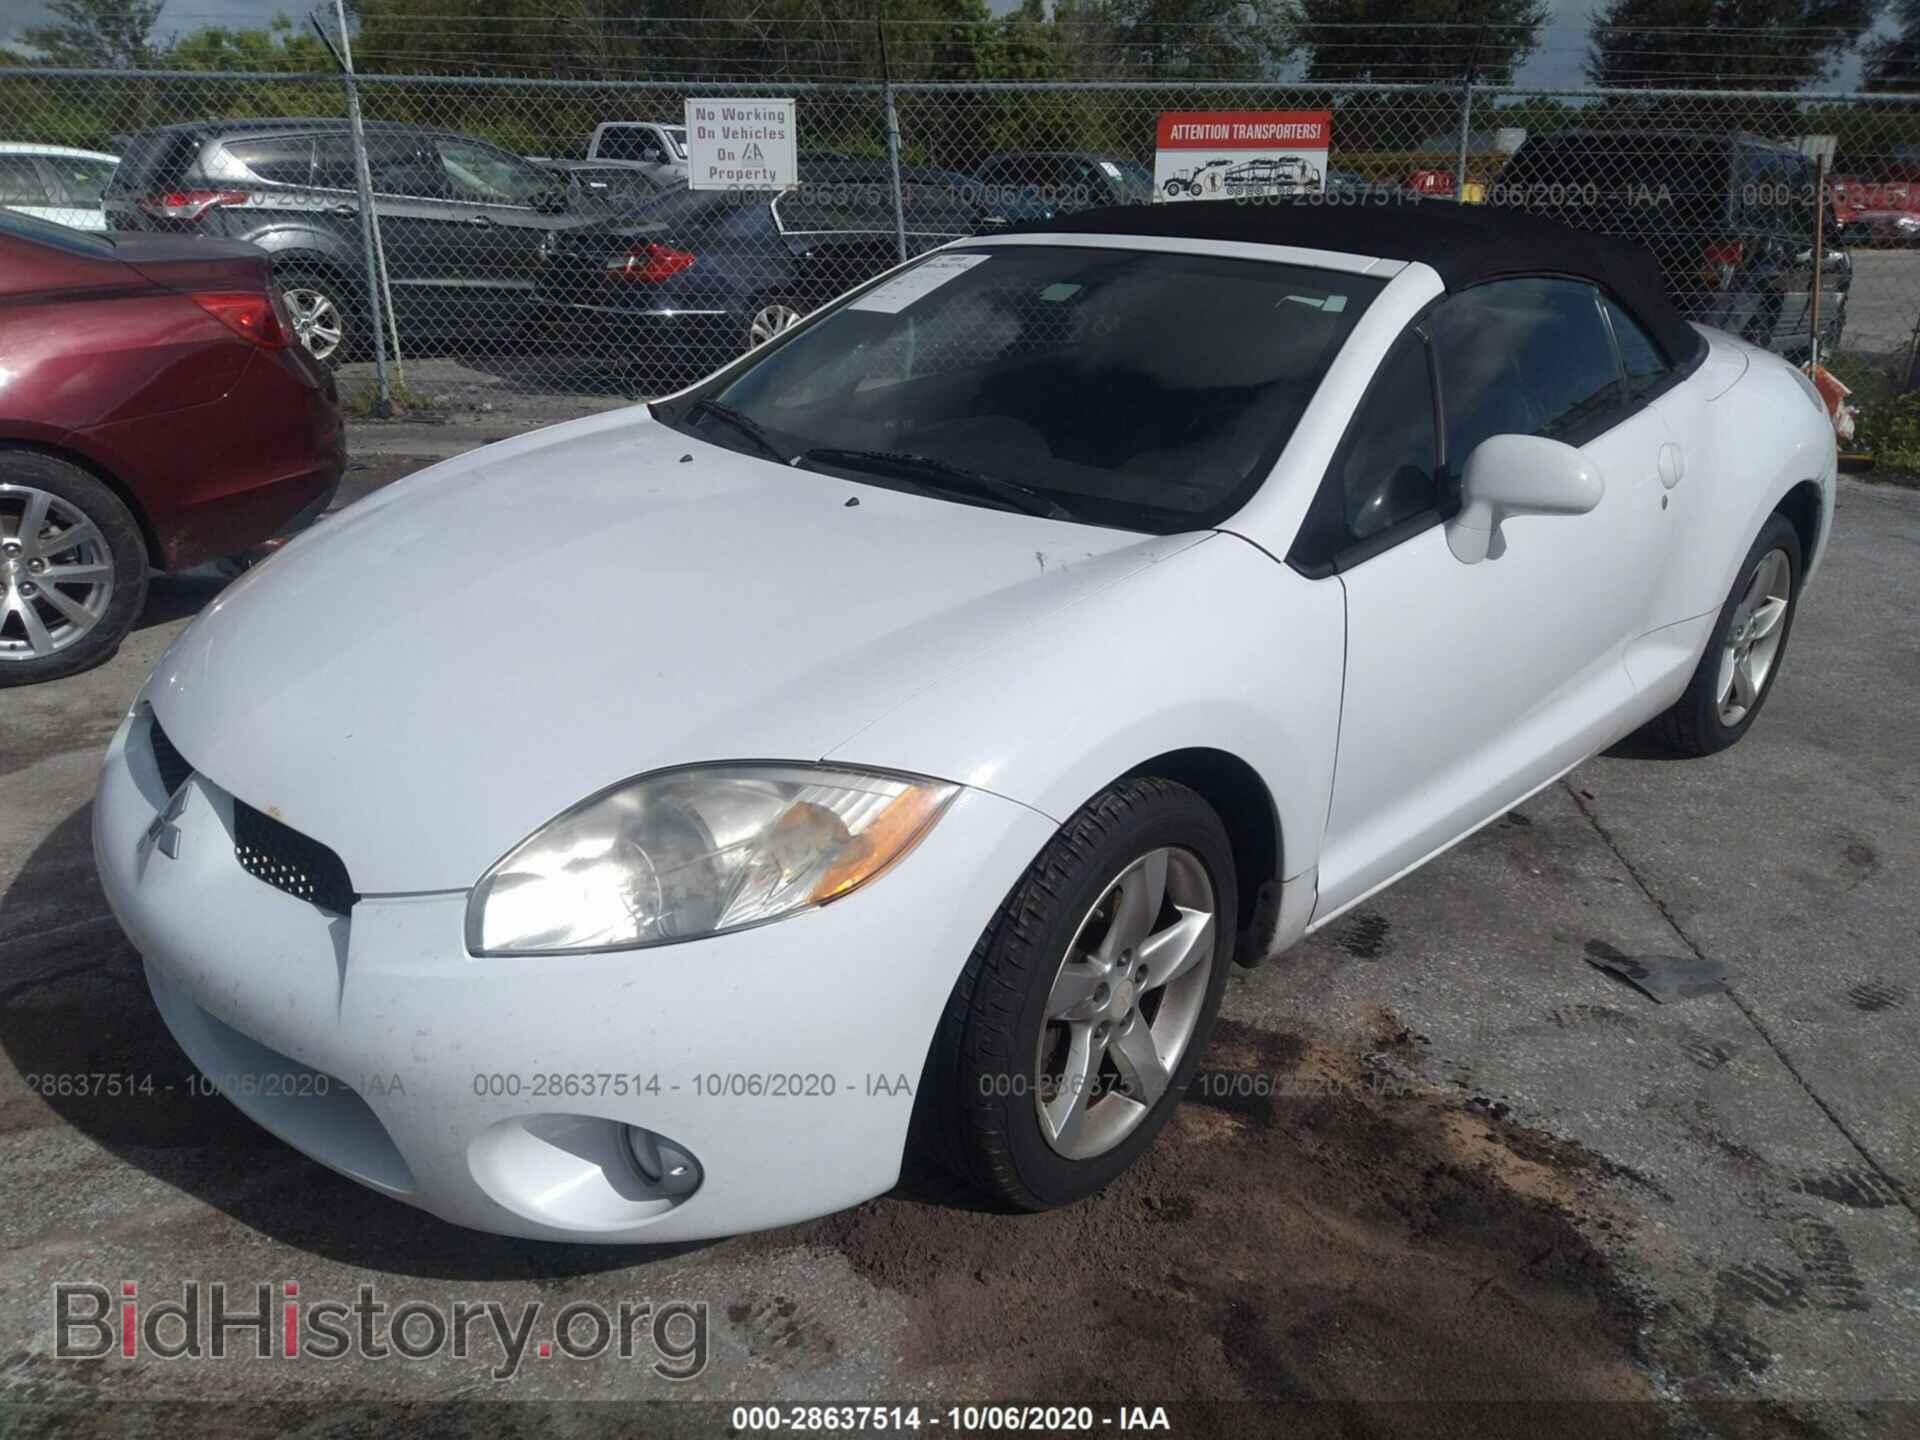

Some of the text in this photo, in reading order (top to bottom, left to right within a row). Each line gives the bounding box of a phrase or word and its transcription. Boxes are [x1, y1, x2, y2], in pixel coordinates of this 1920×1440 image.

[695, 107, 785, 124] No Working
[697, 126, 785, 140] On Vehicles
[1170, 123, 1321, 140] ATTENTION TRANSPORTERS!
[718, 148, 735, 160] On
[709, 166, 776, 182] Property
